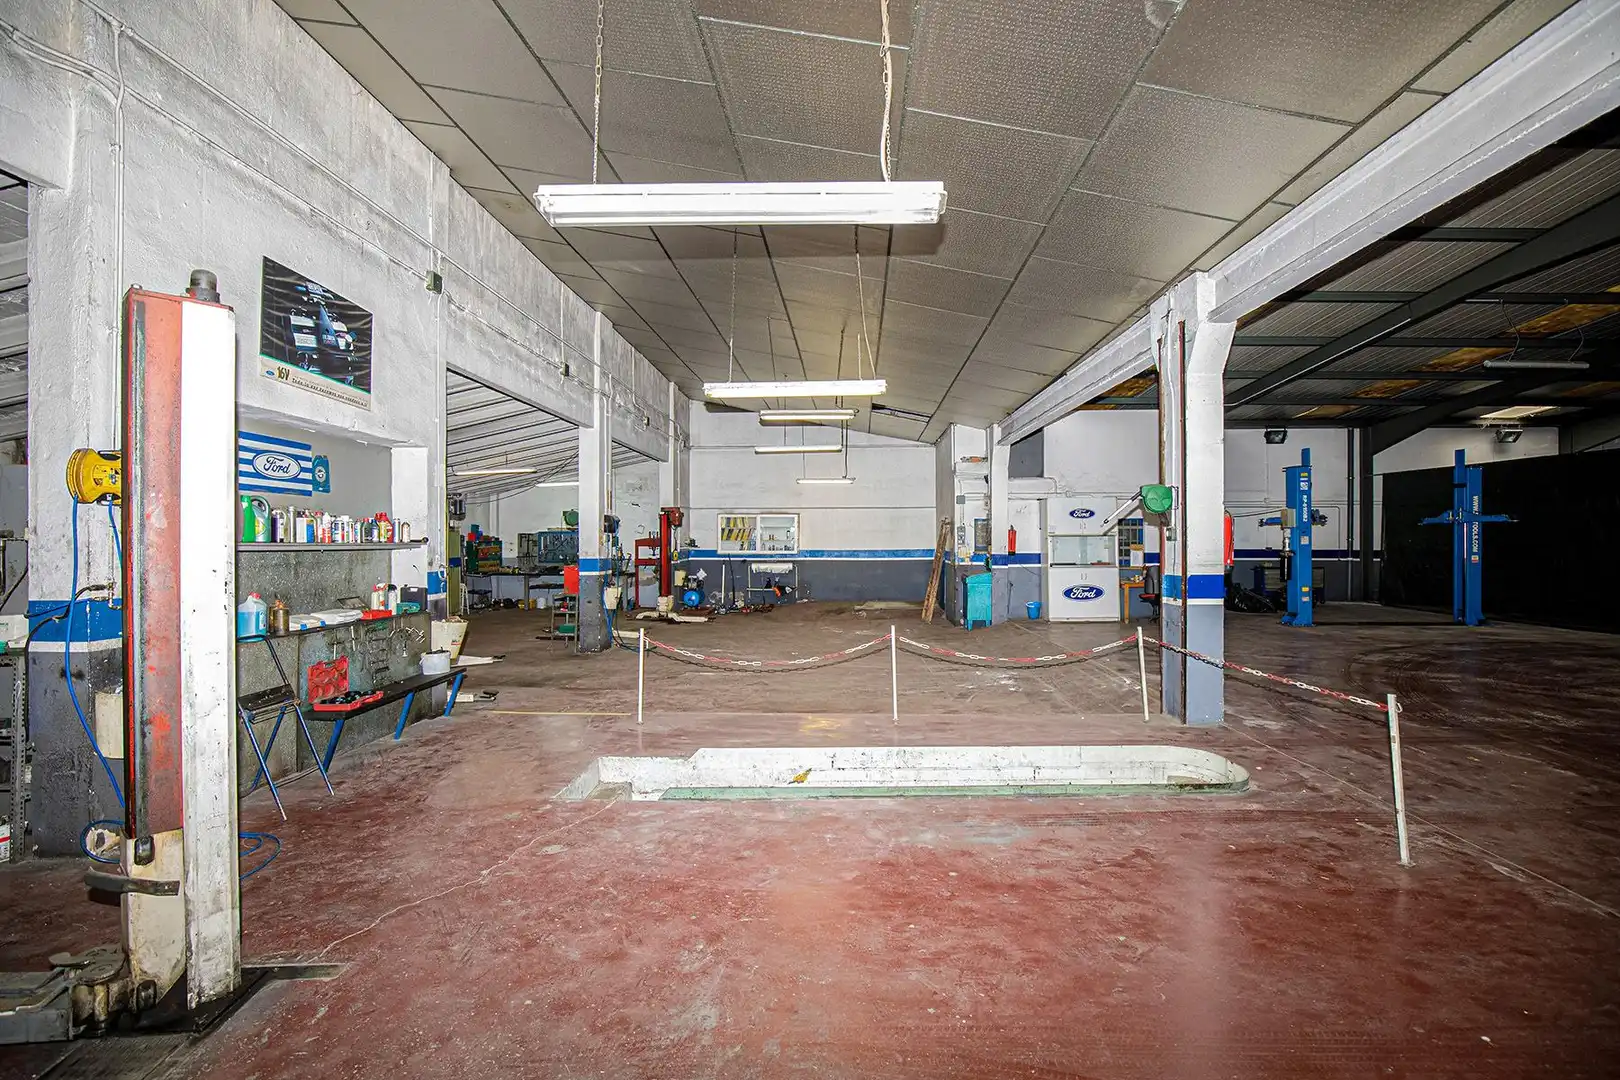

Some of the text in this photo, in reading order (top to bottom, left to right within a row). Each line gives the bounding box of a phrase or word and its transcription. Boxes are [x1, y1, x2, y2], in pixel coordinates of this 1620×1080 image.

[277, 366, 290, 380] 16V
[263, 457, 292, 474] Ford
[1073, 509, 1091, 518] Ford
[1070, 587, 1096, 598] Ford
